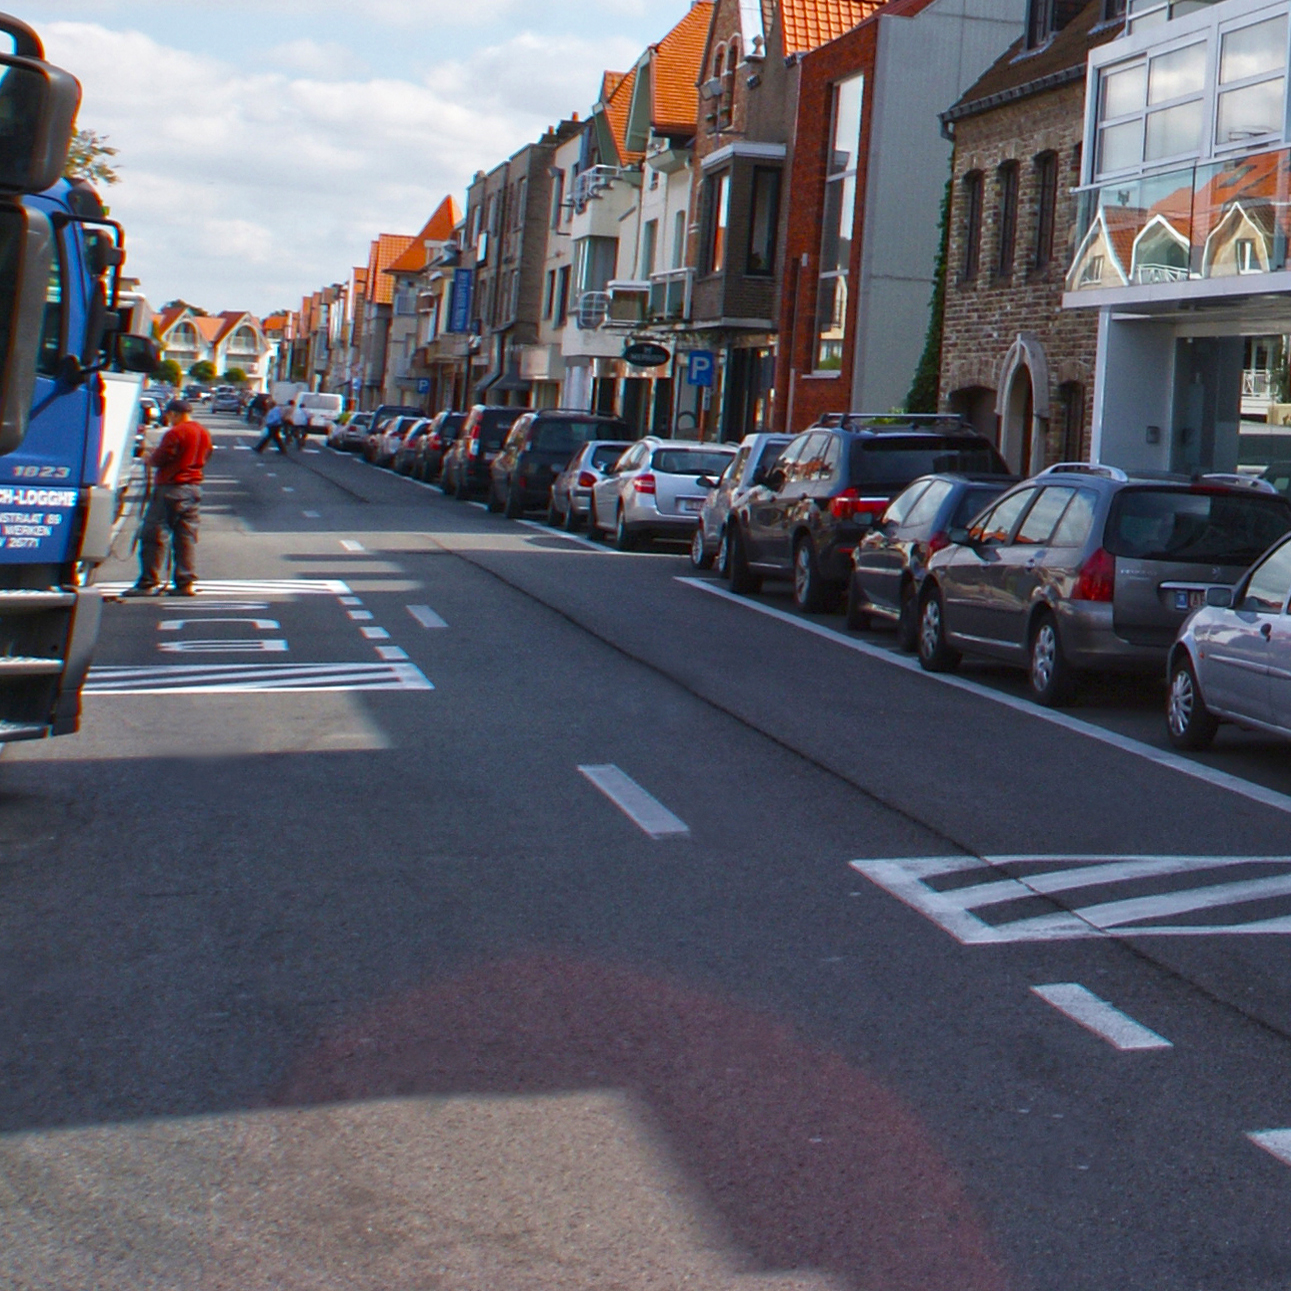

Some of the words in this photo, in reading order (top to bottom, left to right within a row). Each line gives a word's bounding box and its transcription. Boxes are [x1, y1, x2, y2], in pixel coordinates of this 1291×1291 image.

[692, 356, 711, 381] P
[418, 379, 429, 391] P
[13, 466, 71, 479] 1823
[3, 525, 52, 537] WERKEN
